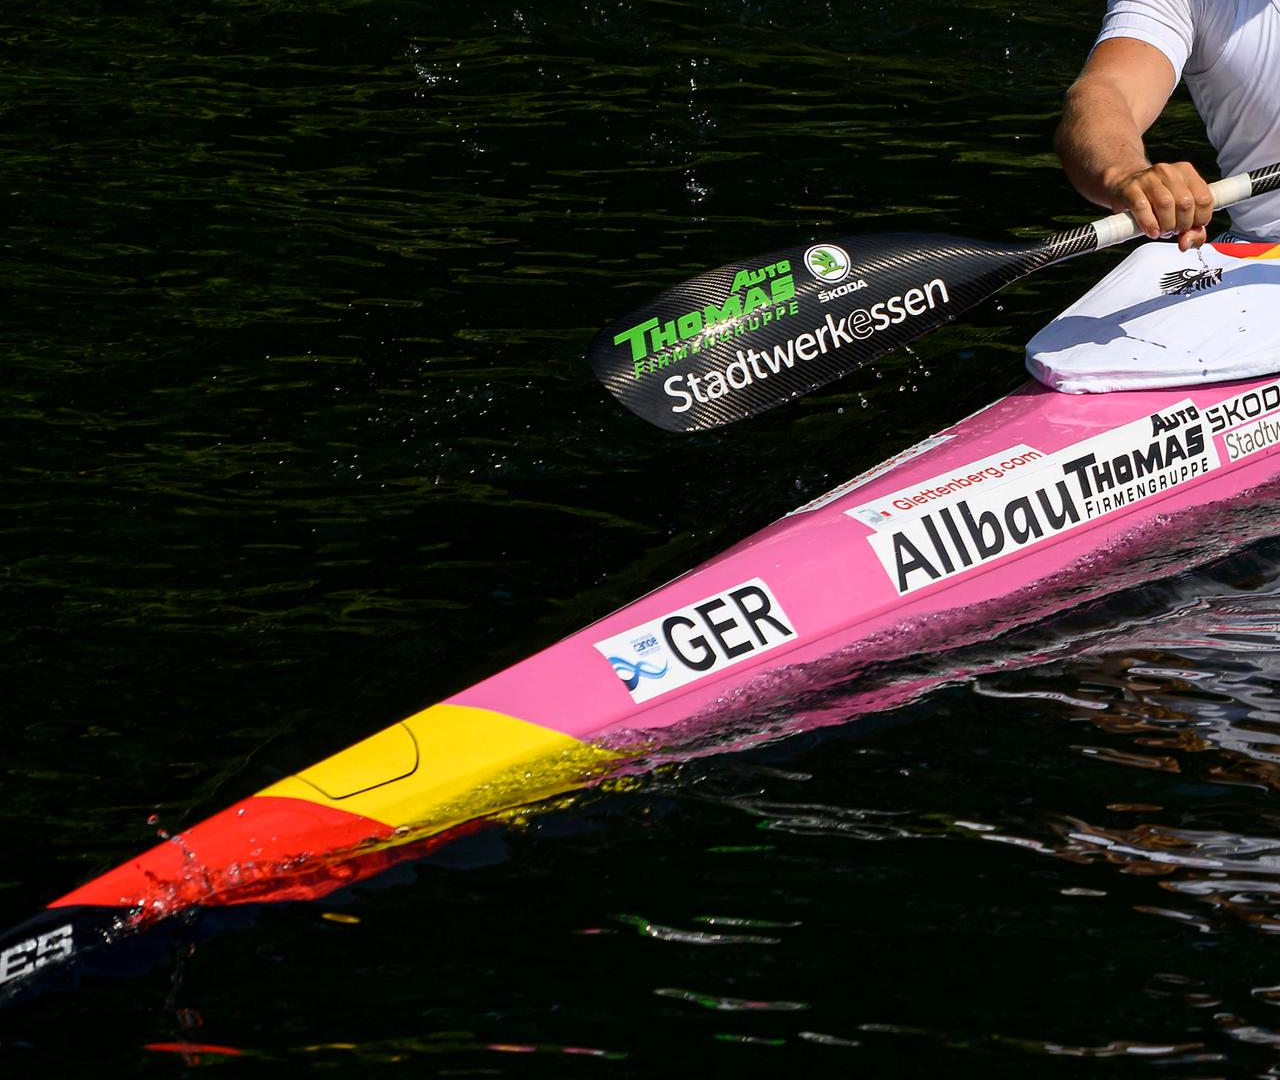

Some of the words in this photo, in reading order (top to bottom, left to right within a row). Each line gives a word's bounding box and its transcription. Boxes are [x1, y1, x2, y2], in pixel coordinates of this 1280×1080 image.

[613, 275, 797, 363] THOMAS
[634, 301, 799, 380] FIRMENGRUPPE
[663, 277, 950, 413] Stadtwerkessen
[892, 449, 1043, 511] Glettenberg.com
[1062, 423, 1206, 500] THOMAS
[1085, 457, 1209, 520] FIRMENGRUPPE
[892, 480, 1081, 593] Allbau
[662, 585, 793, 672] GER
